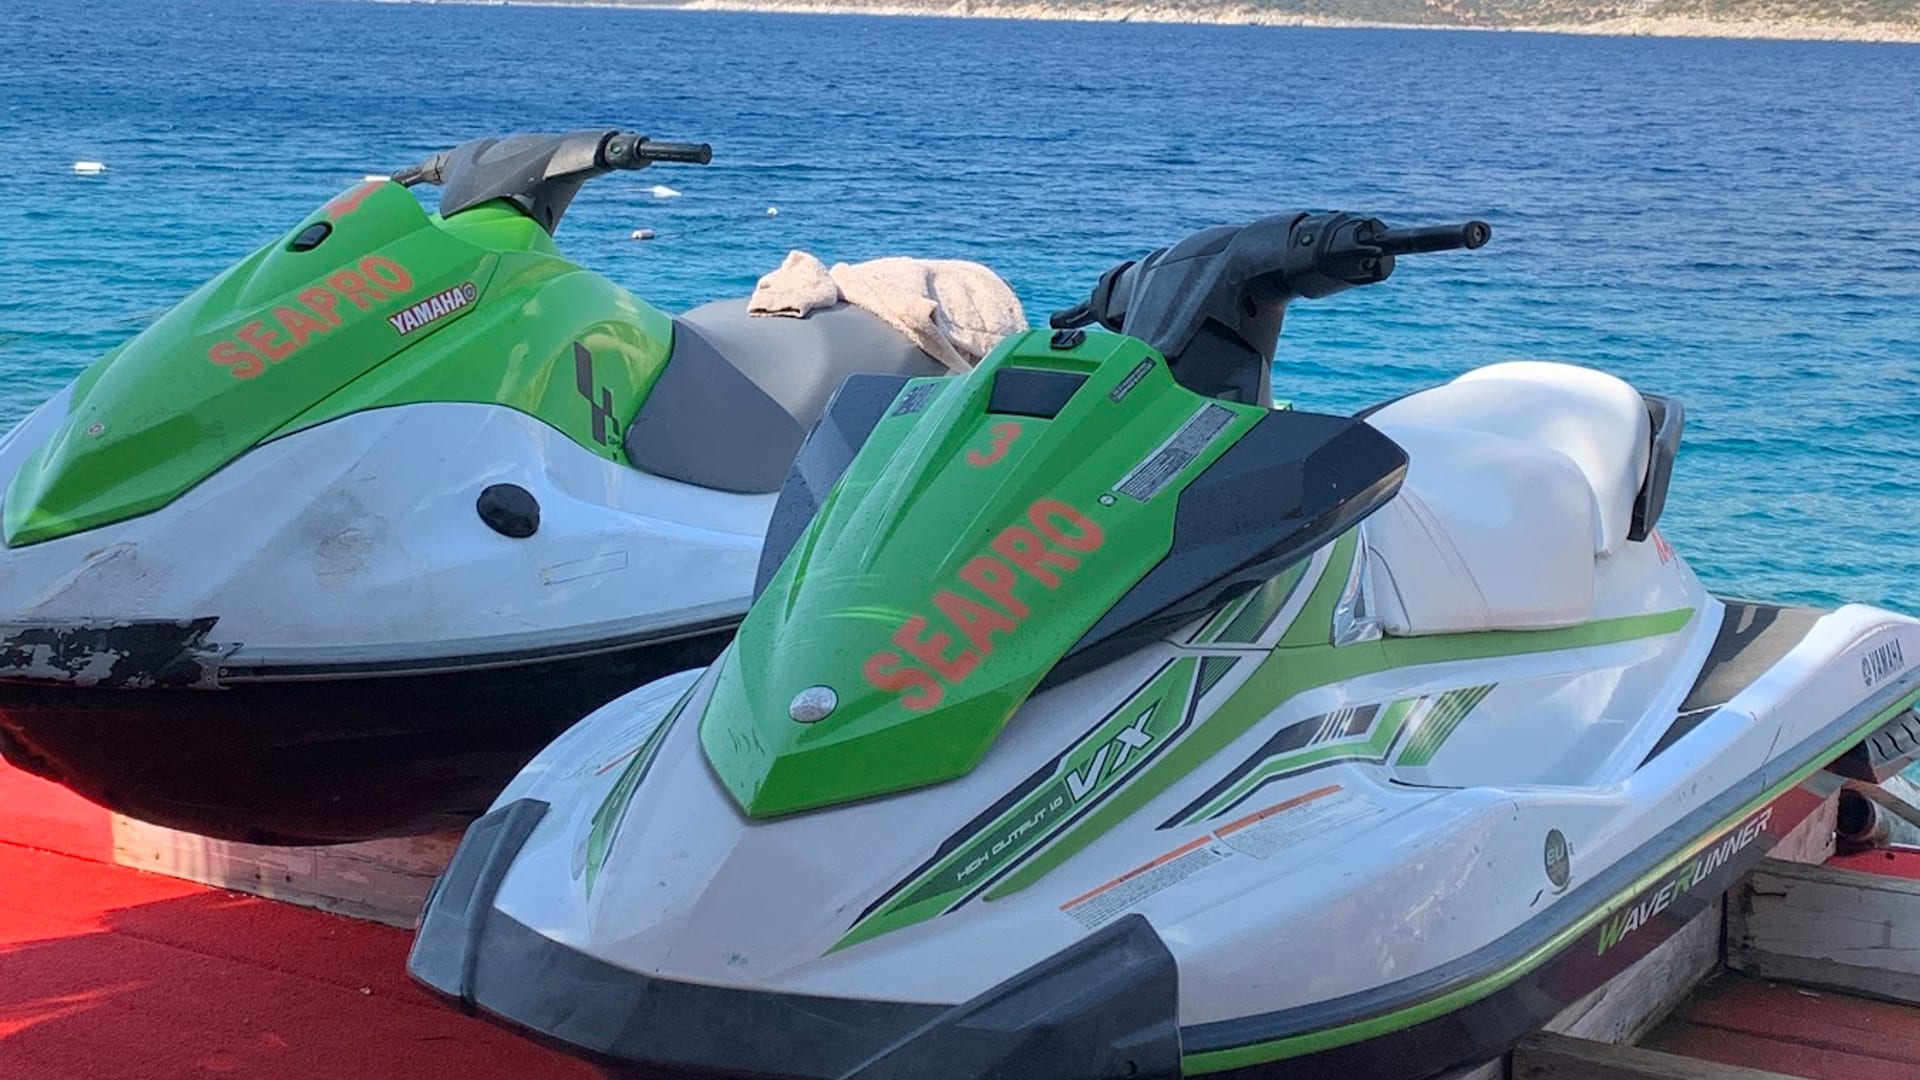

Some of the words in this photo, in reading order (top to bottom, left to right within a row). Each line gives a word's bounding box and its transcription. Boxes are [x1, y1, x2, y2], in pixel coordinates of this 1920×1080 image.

[208, 255, 413, 380] SEAPRO
[388, 286, 467, 335] YAMAHA
[966, 422, 1022, 467] 3
[863, 499, 1105, 710] SEAPRO
[1868, 637, 1905, 684] YAMAHA
[1064, 700, 1158, 803] VX
[992, 807, 1046, 855] OUTPUT
